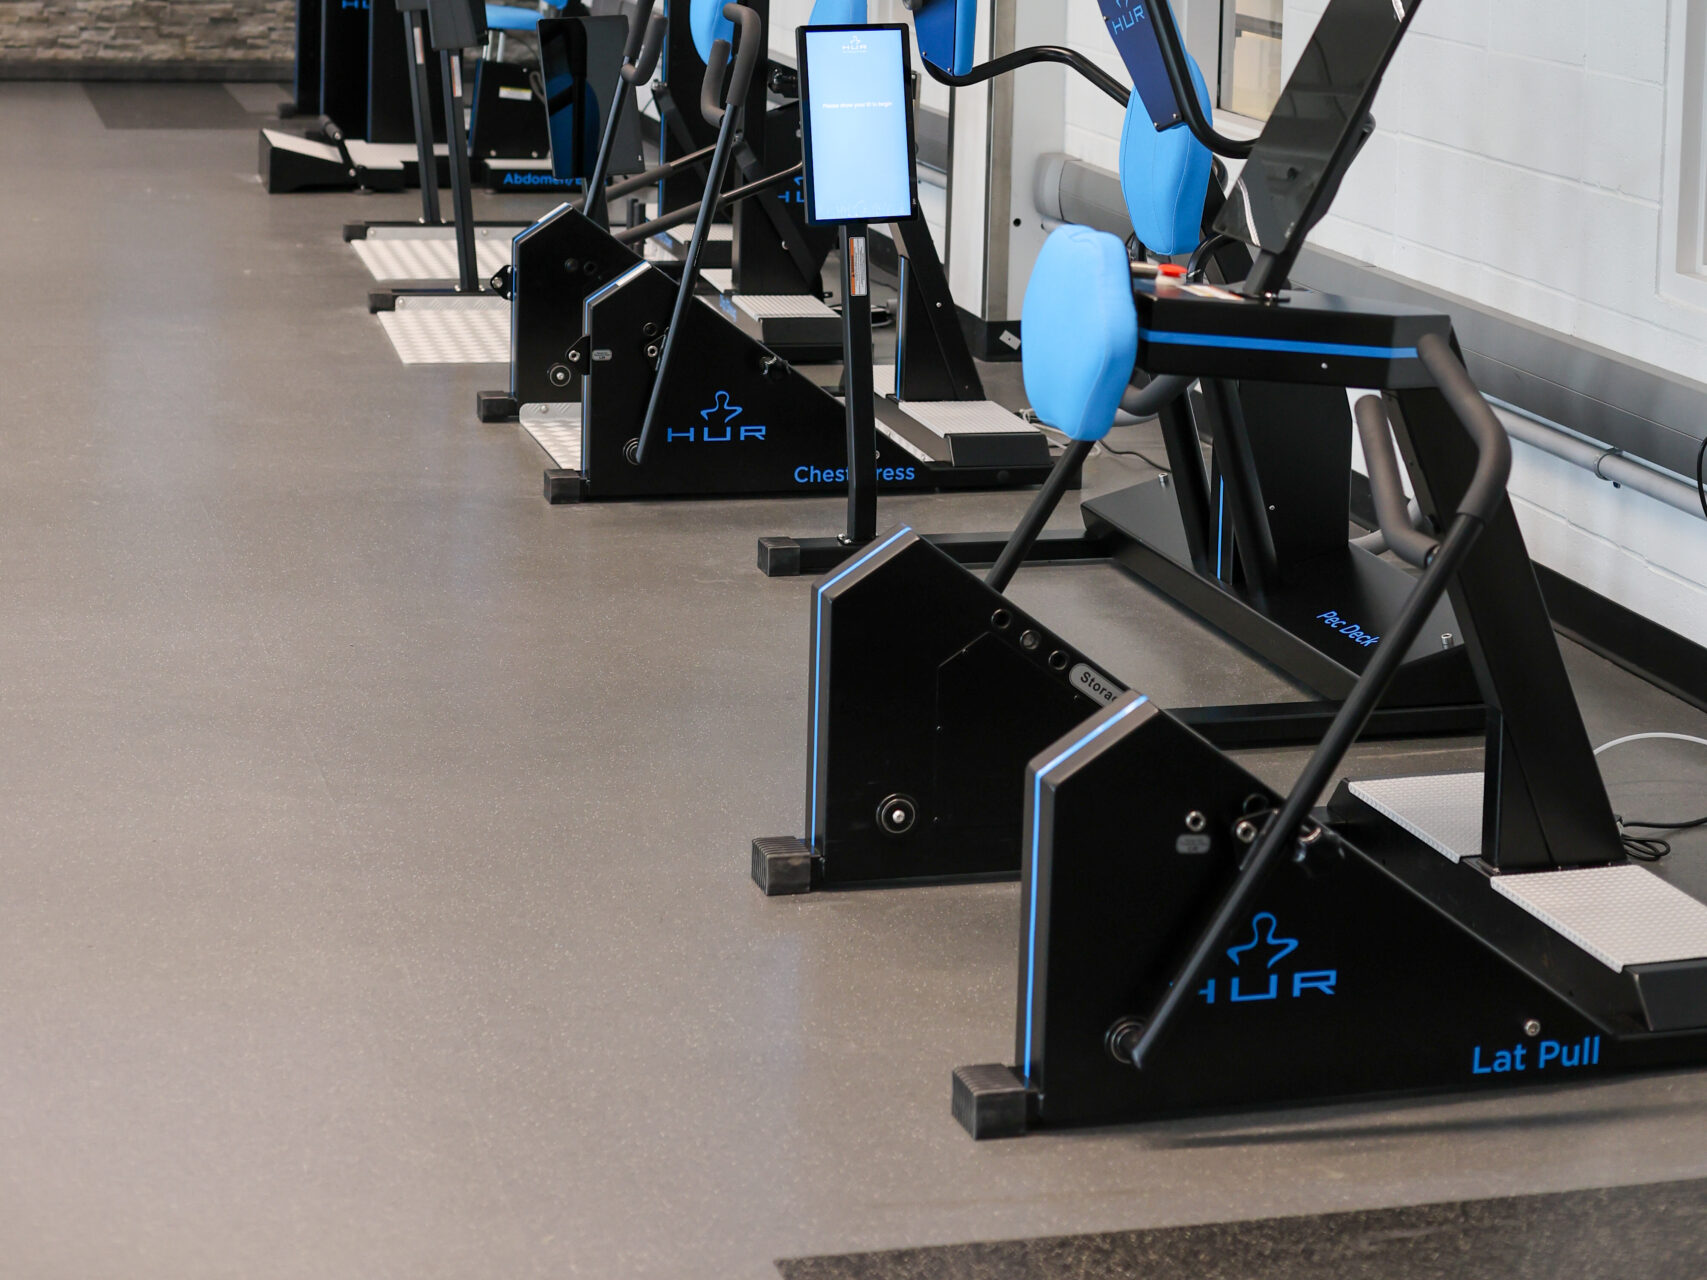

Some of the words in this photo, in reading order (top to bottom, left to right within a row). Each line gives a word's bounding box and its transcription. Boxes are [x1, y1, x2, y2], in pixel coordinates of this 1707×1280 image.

[1112, 3, 1145, 36] HUR
[667, 424, 766, 442] HUR
[794, 465, 848, 484] Ches
[876, 466, 915, 481] ress
[1316, 610, 1346, 629] Pec
[1342, 622, 1382, 647] Deck
[1080, 672, 1117, 702] Stora
[1472, 1044, 1526, 1075] Lat
[1539, 1036, 1600, 1070] Pull
